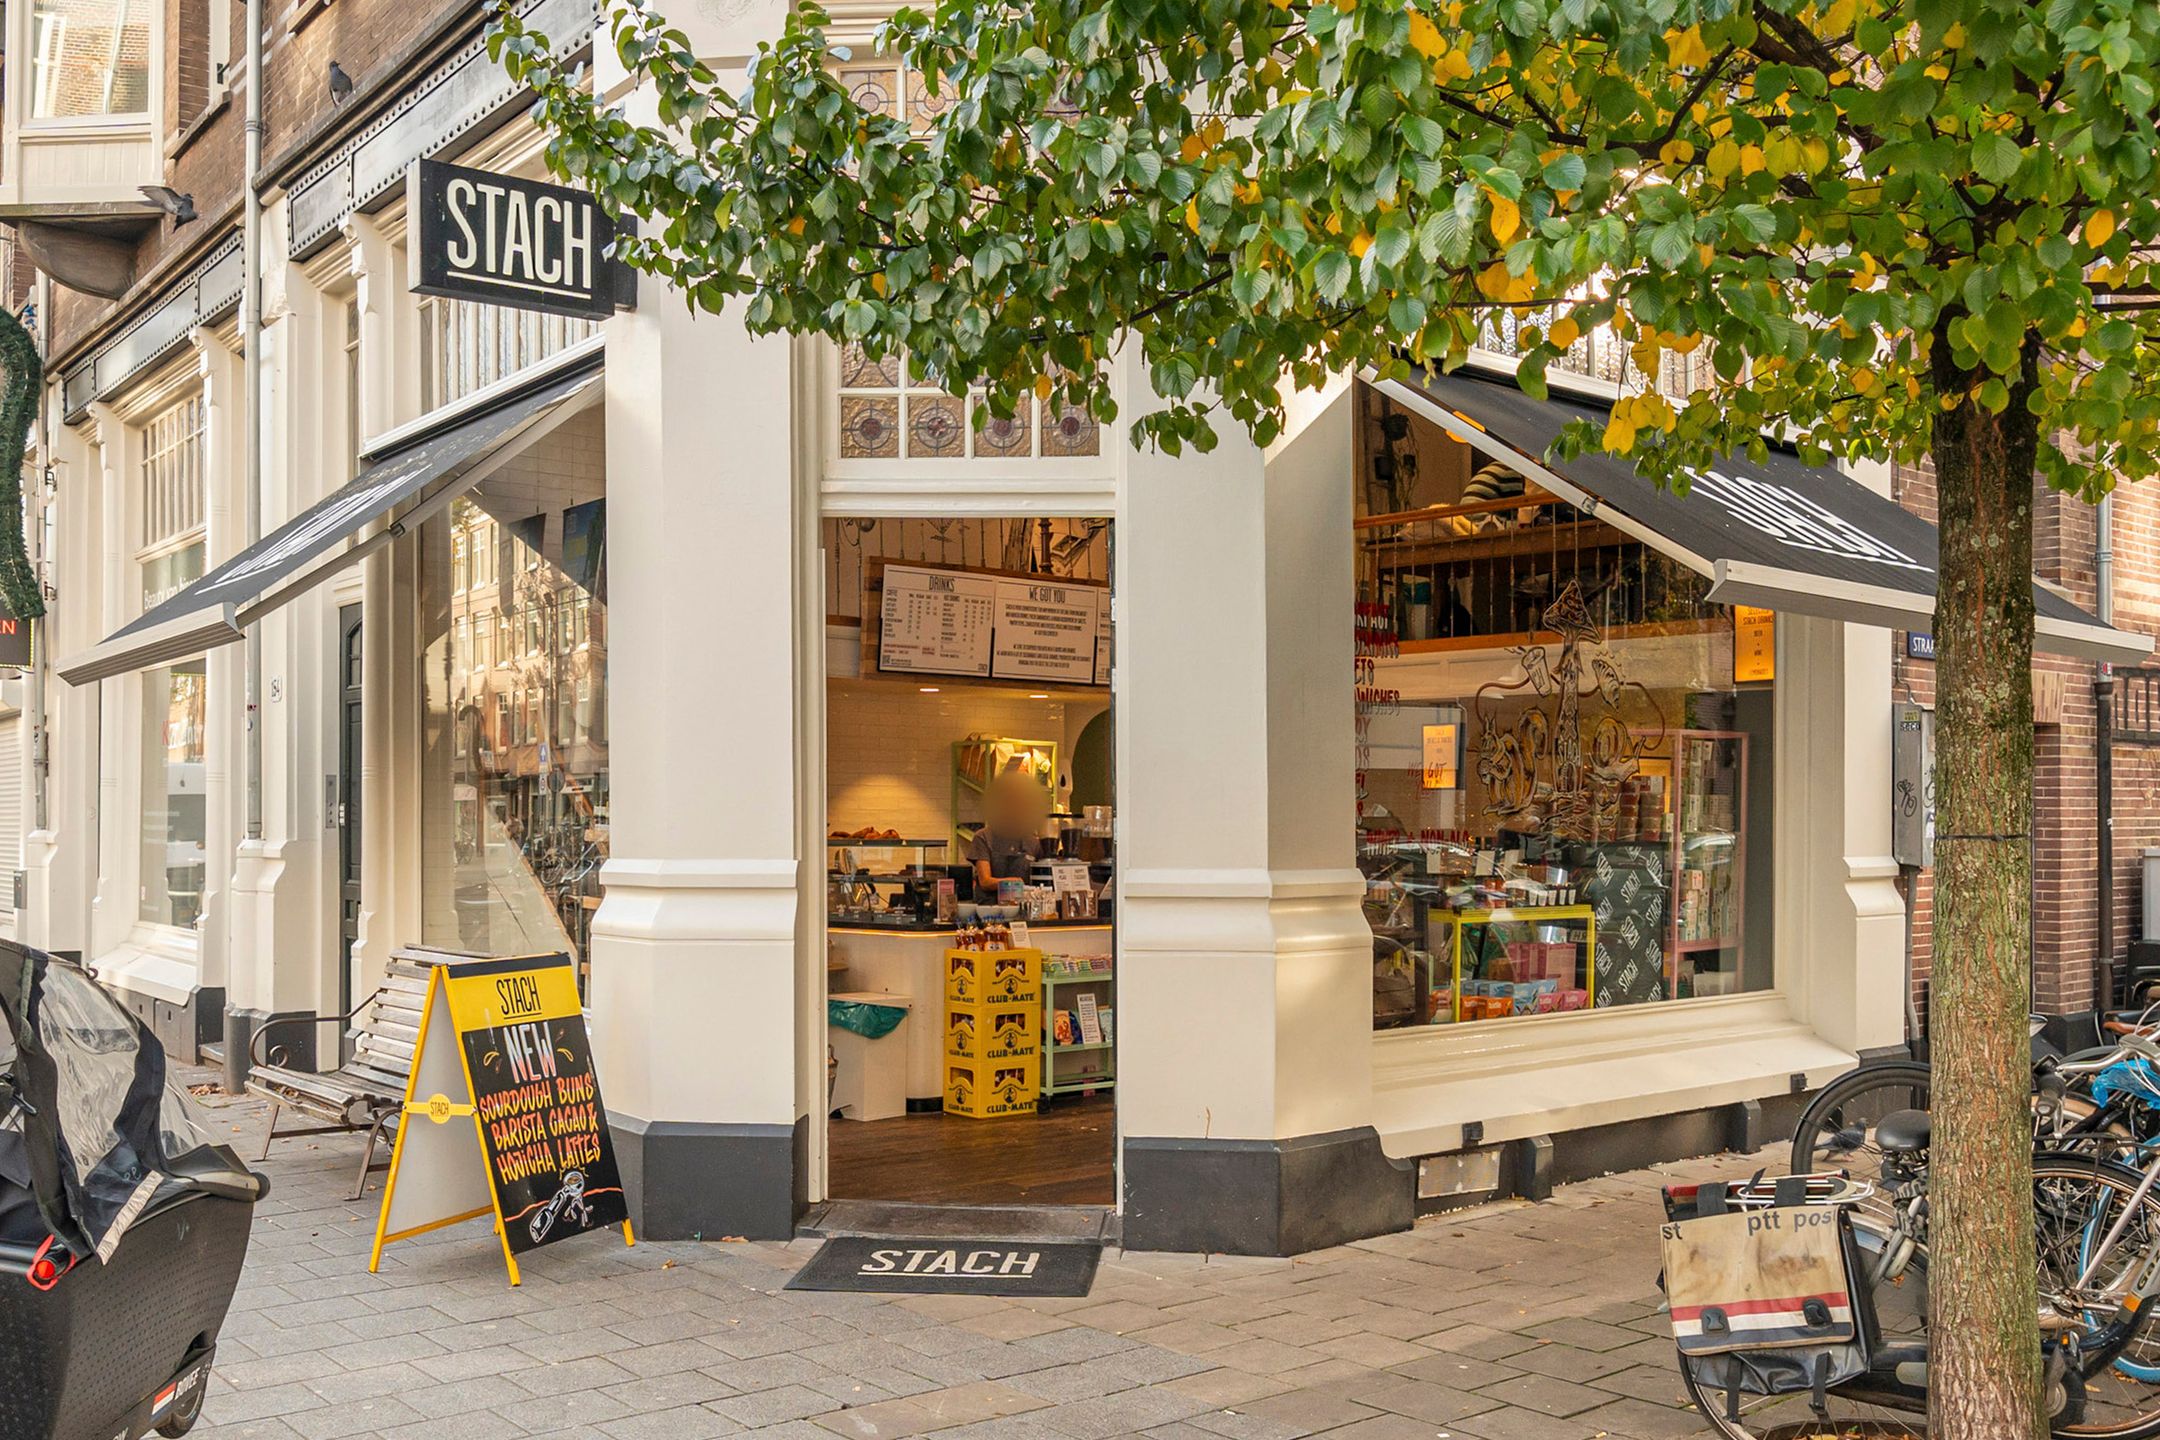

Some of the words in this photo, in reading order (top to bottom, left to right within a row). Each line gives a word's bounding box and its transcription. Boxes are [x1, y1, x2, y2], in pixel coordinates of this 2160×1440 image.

[447, 178, 592, 289] STACH
[929, 576, 955, 592] DRINKS
[1029, 587, 1039, 601] WE
[1040, 588, 1052, 602] GOT
[1053, 590, 1066, 603] YOU
[0, 619, 16, 635] N
[1621, 870, 1641, 904] STACH
[1621, 916, 1640, 950] STACH
[1618, 959, 1639, 993] STACH
[496, 976, 541, 1016] STACH
[987, 993, 1035, 1004] CLUB-MATE
[503, 1022, 557, 1084] NEW
[987, 1046, 1035, 1059] CLUB-MATE
[430, 1101, 449, 1115] STACH
[479, 1080, 553, 1124] SOURDOUGH
[556, 1072, 594, 1104] BUNS
[986, 1102, 1033, 1114] CLUB-MATE
[491, 1112, 547, 1151] BARISTA
[1662, 1223, 1683, 1240] st
[1747, 1210, 1781, 1236] ptt
[861, 1250, 1041, 1274] STACH
